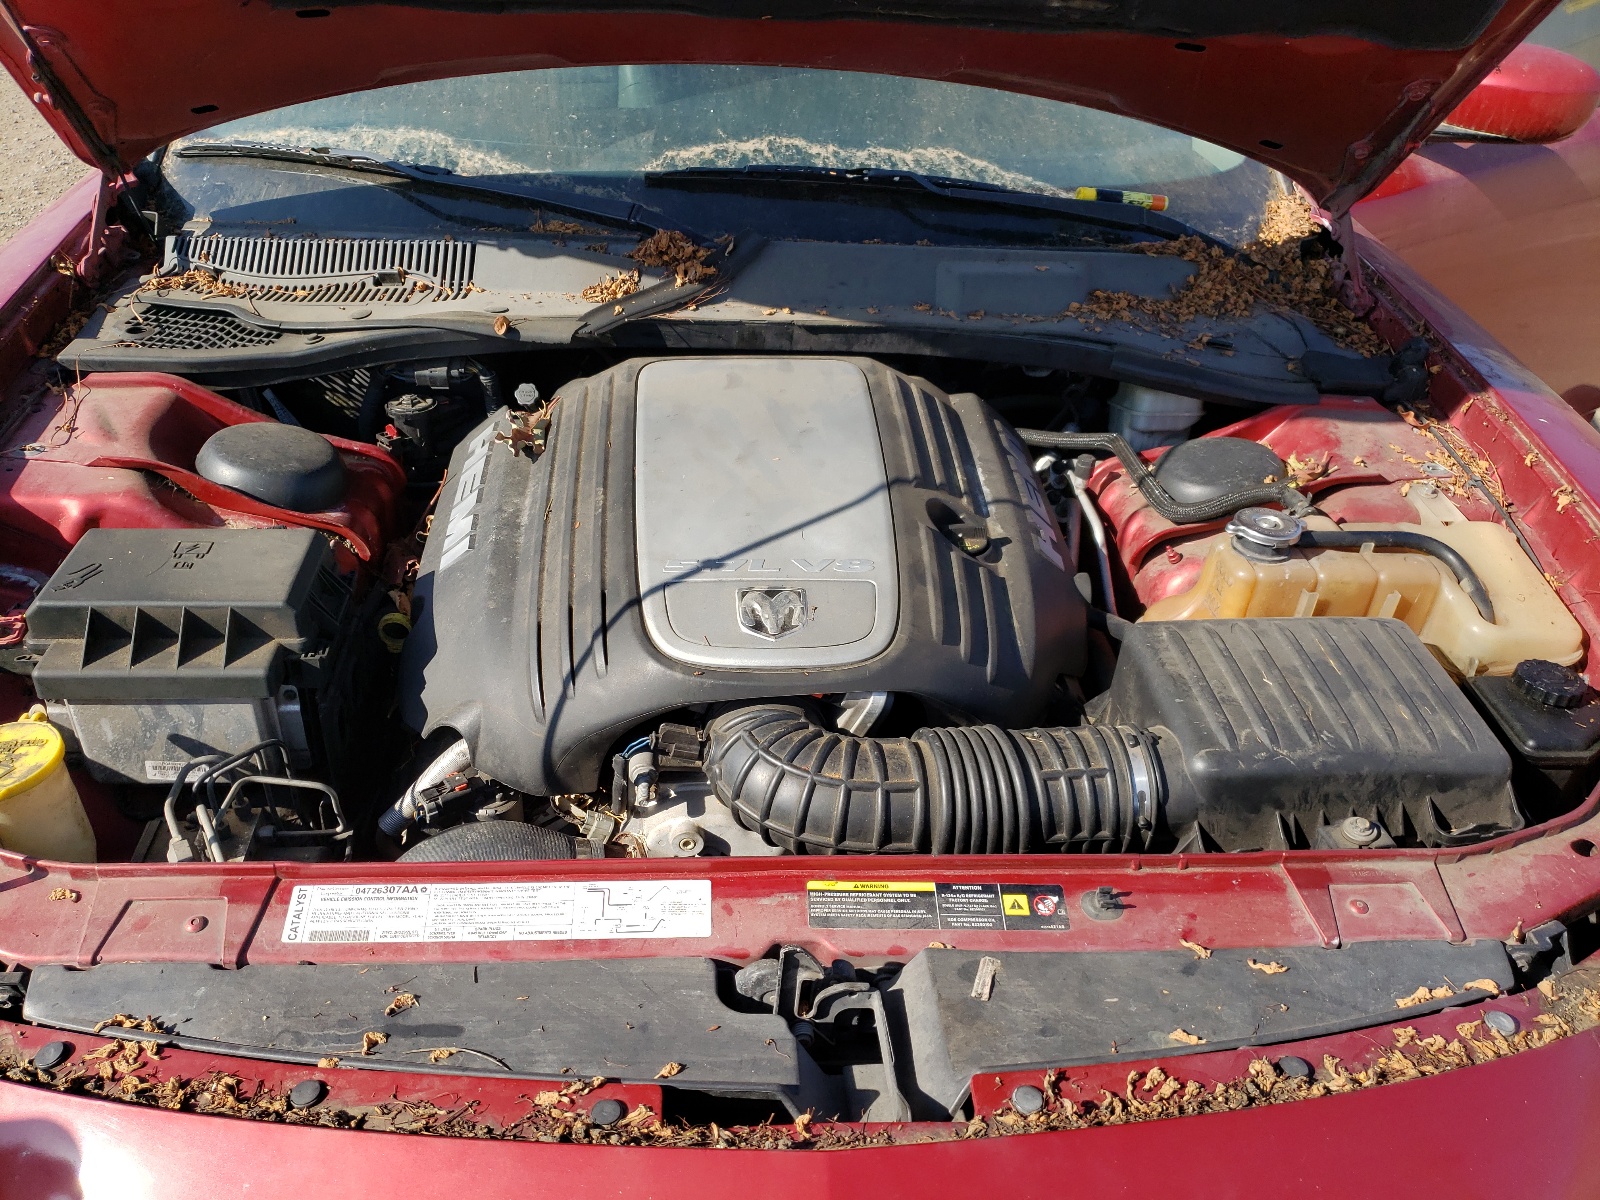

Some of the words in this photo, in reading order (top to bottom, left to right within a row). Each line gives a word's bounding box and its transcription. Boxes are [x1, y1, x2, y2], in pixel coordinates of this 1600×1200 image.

[439, 421, 497, 573] HEMI
[995, 419, 1065, 572] HEMI
[662, 558, 781, 572] 5.7L
[791, 558, 876, 572] V8
[288, 887, 308, 941] CATALYST
[355, 885, 418, 895] 04726307AA
